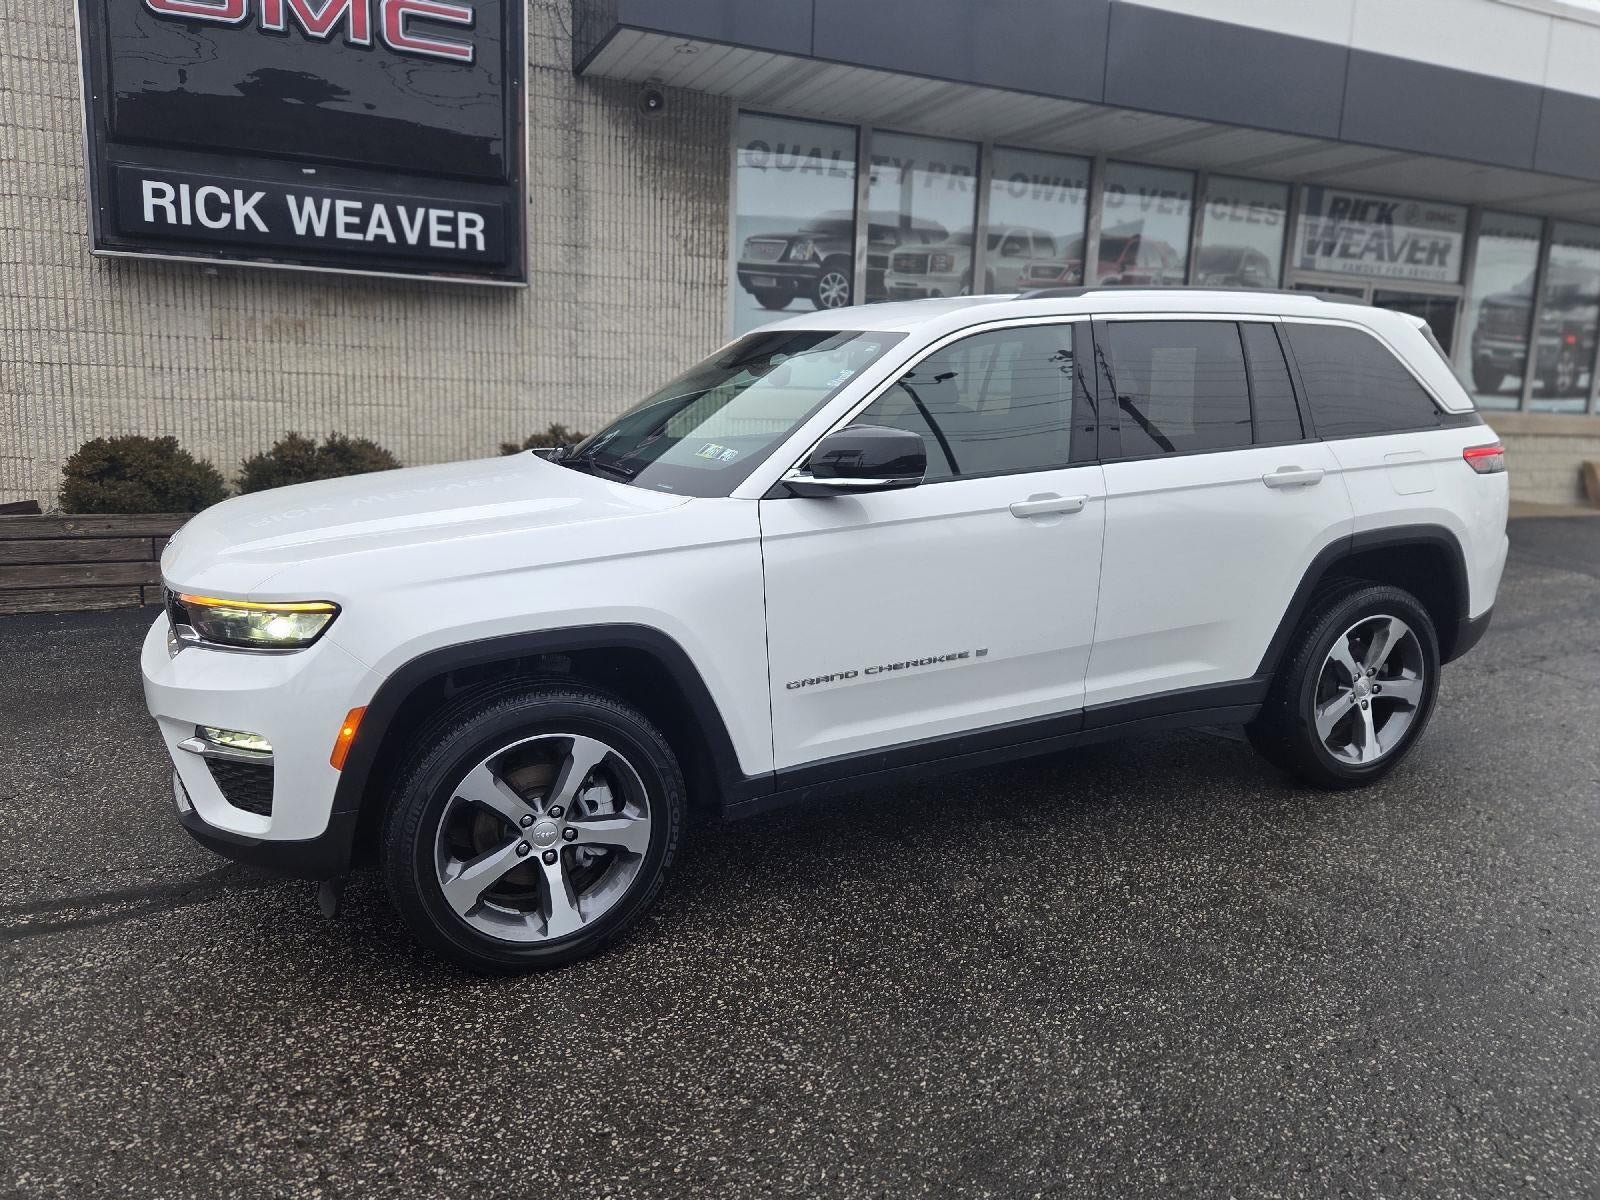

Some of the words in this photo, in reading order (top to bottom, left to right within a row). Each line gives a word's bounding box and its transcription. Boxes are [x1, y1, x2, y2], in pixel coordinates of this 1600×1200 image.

[142, 180, 270, 233] RICK
[286, 194, 486, 251] WEAVER
[1323, 195, 1400, 225] RICK
[1305, 222, 1453, 268] WEAVER
[786, 669, 859, 690] GRAND
[864, 650, 970, 675] CHEROKEE
